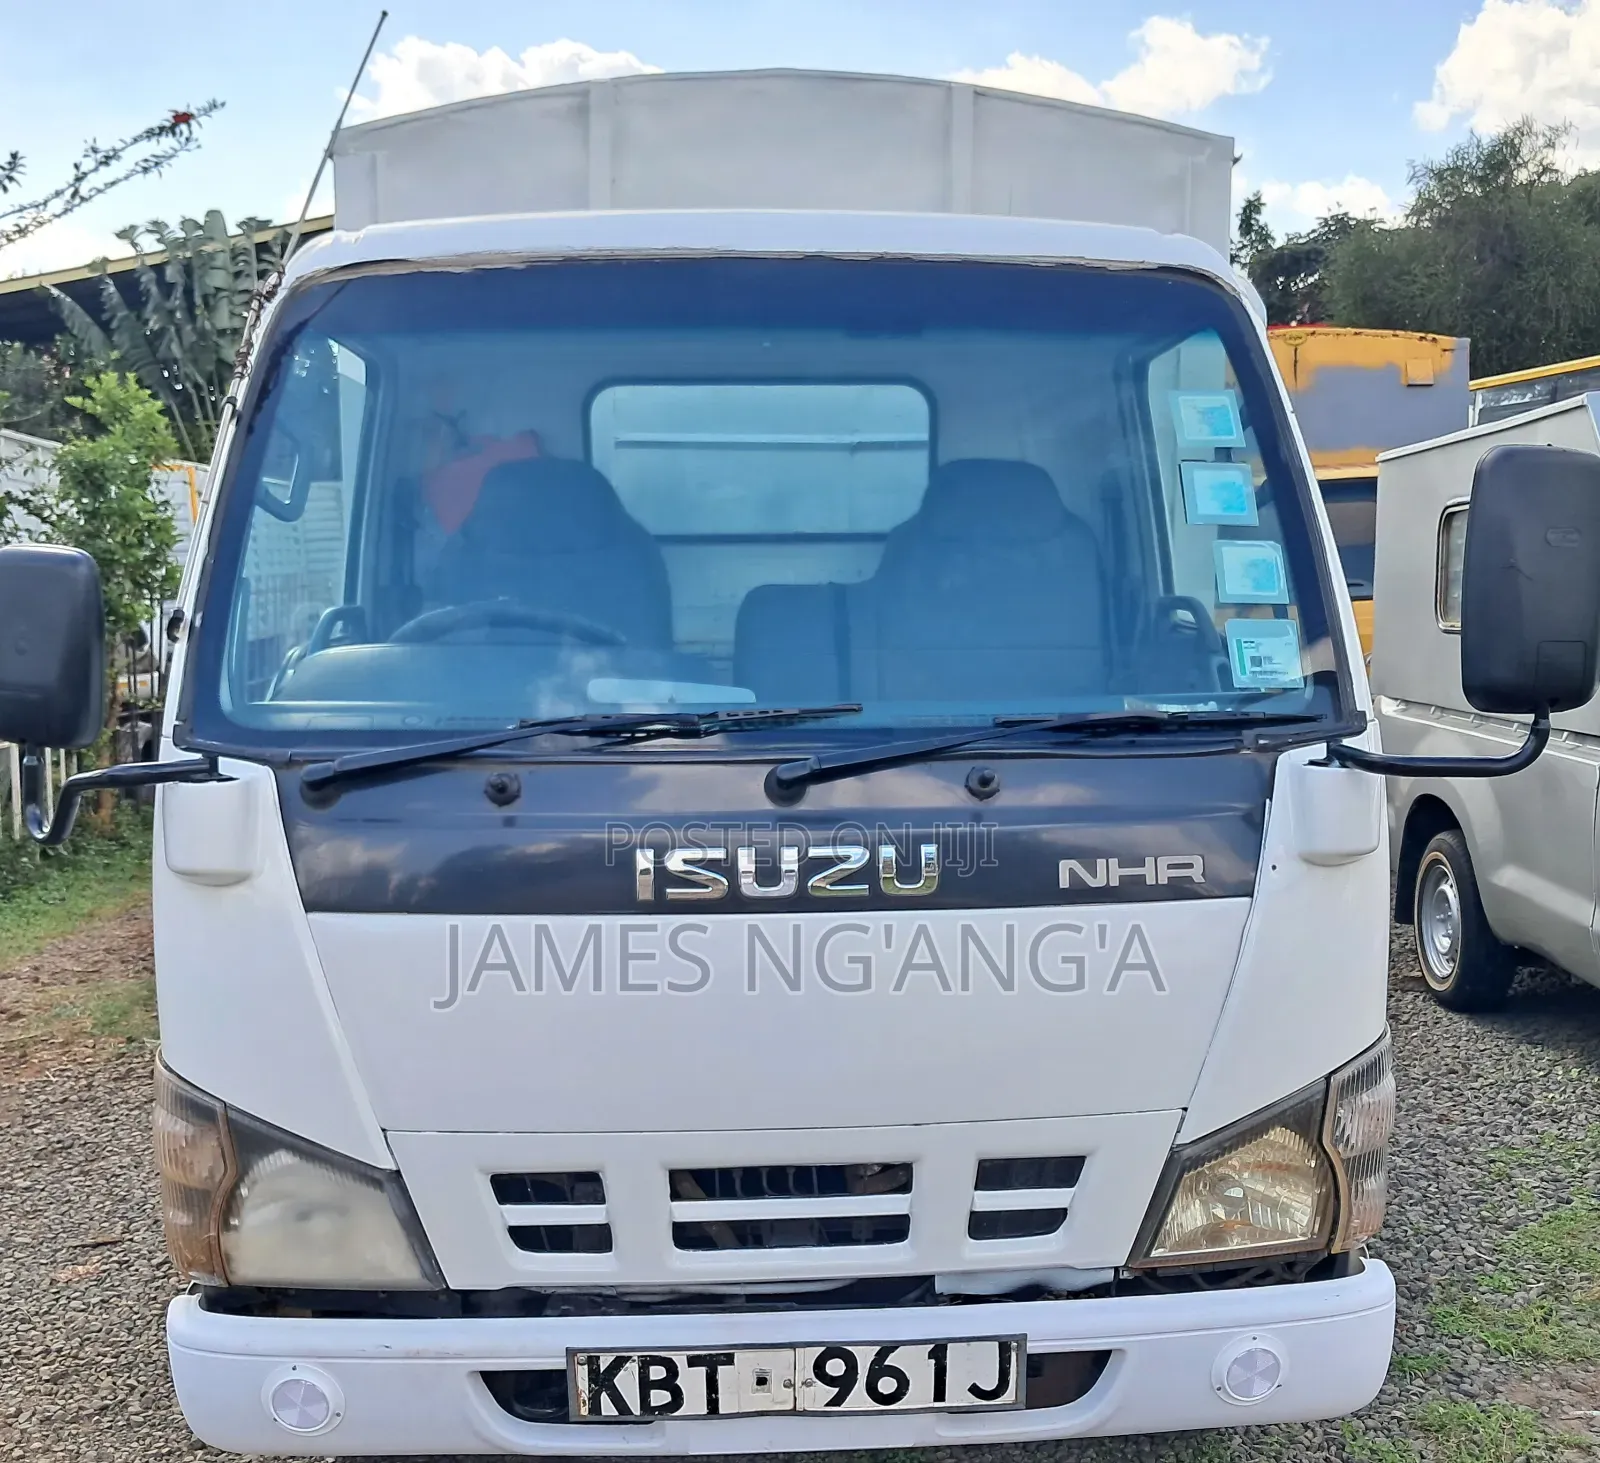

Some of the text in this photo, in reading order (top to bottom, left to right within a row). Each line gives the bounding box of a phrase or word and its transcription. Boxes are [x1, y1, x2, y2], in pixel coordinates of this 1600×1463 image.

[636, 844, 939, 900] ISUZU
[1058, 854, 1206, 889] NHR
[587, 1341, 1014, 1417] KBT 961J
